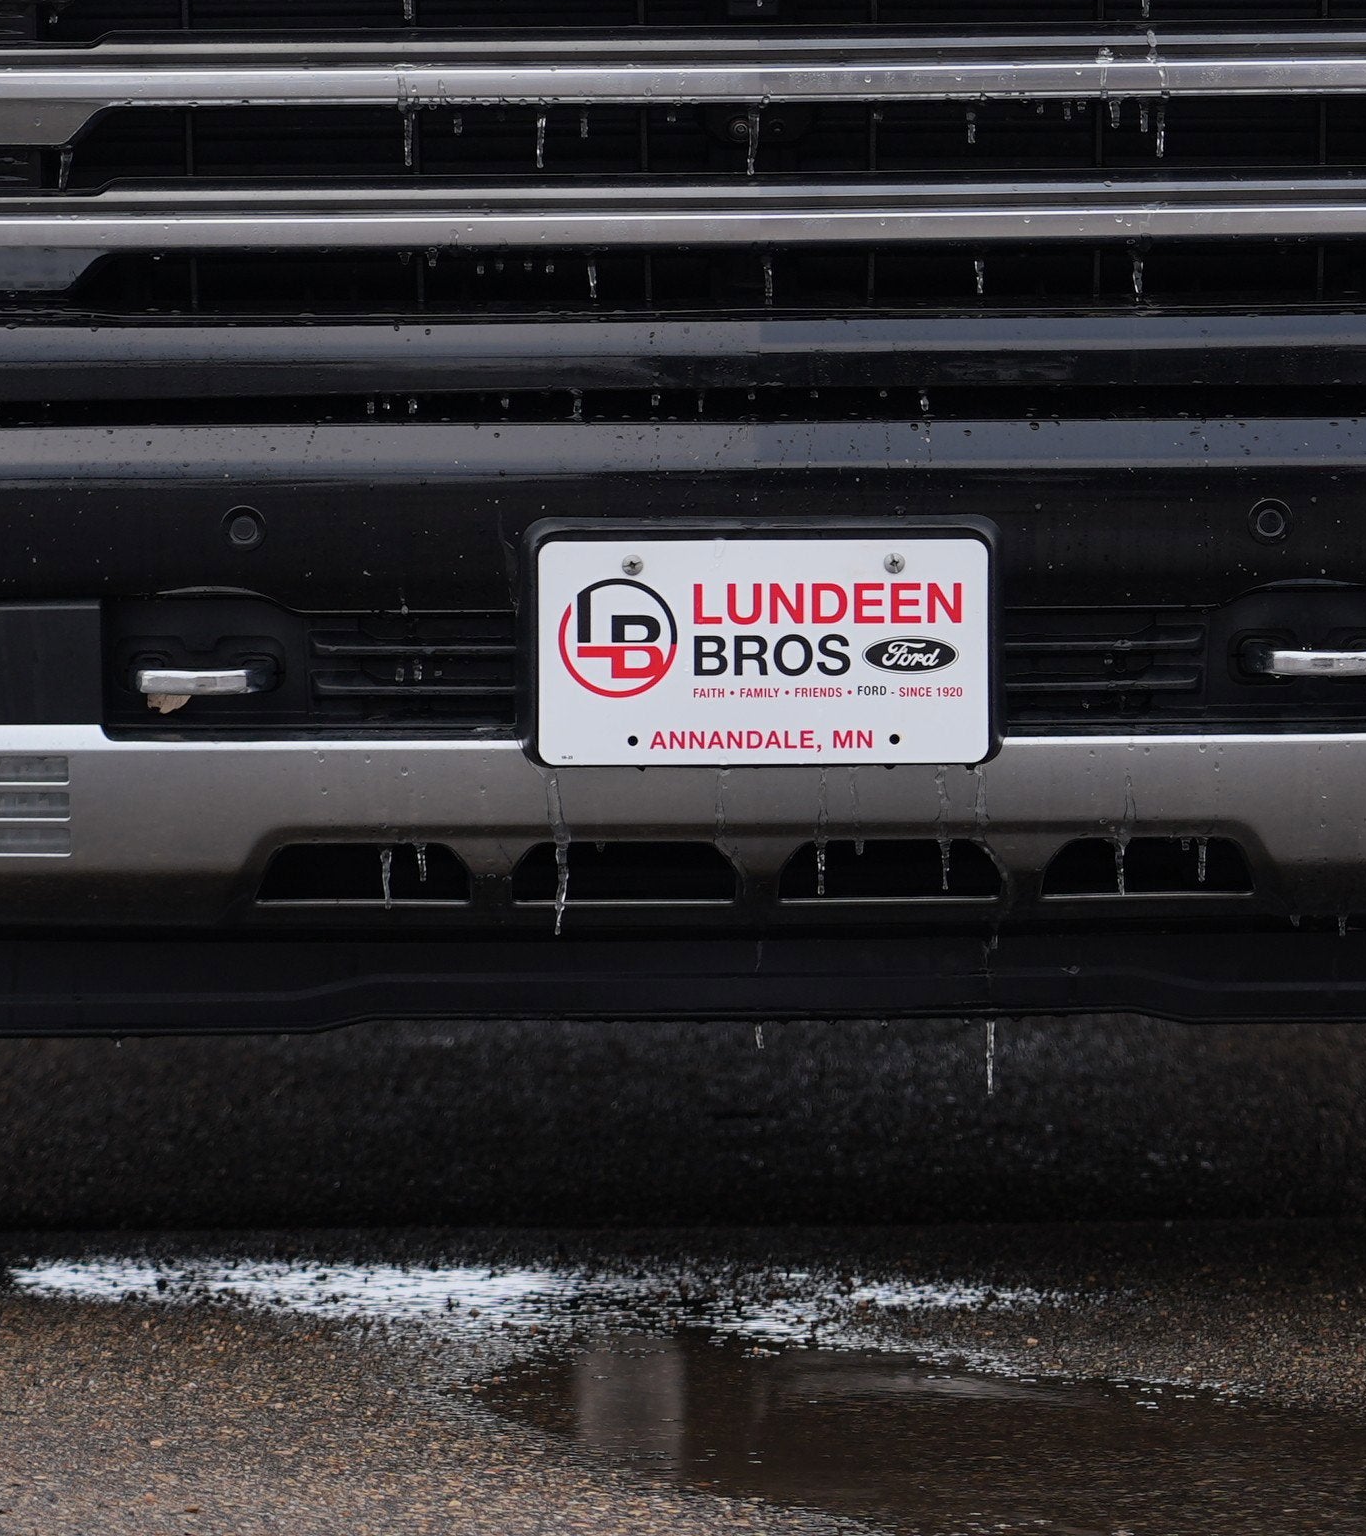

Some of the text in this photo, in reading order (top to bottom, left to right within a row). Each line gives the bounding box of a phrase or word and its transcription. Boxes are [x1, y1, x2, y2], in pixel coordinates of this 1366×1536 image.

[692, 582, 963, 625] LUNDEEN
[692, 633, 852, 677] BROS
[881, 640, 941, 667] Ford
[692, 685, 963, 699] FAITH FAMILY FRIENDS FORD SINCE 1920
[649, 729, 874, 752] ANNANDALE, MN
